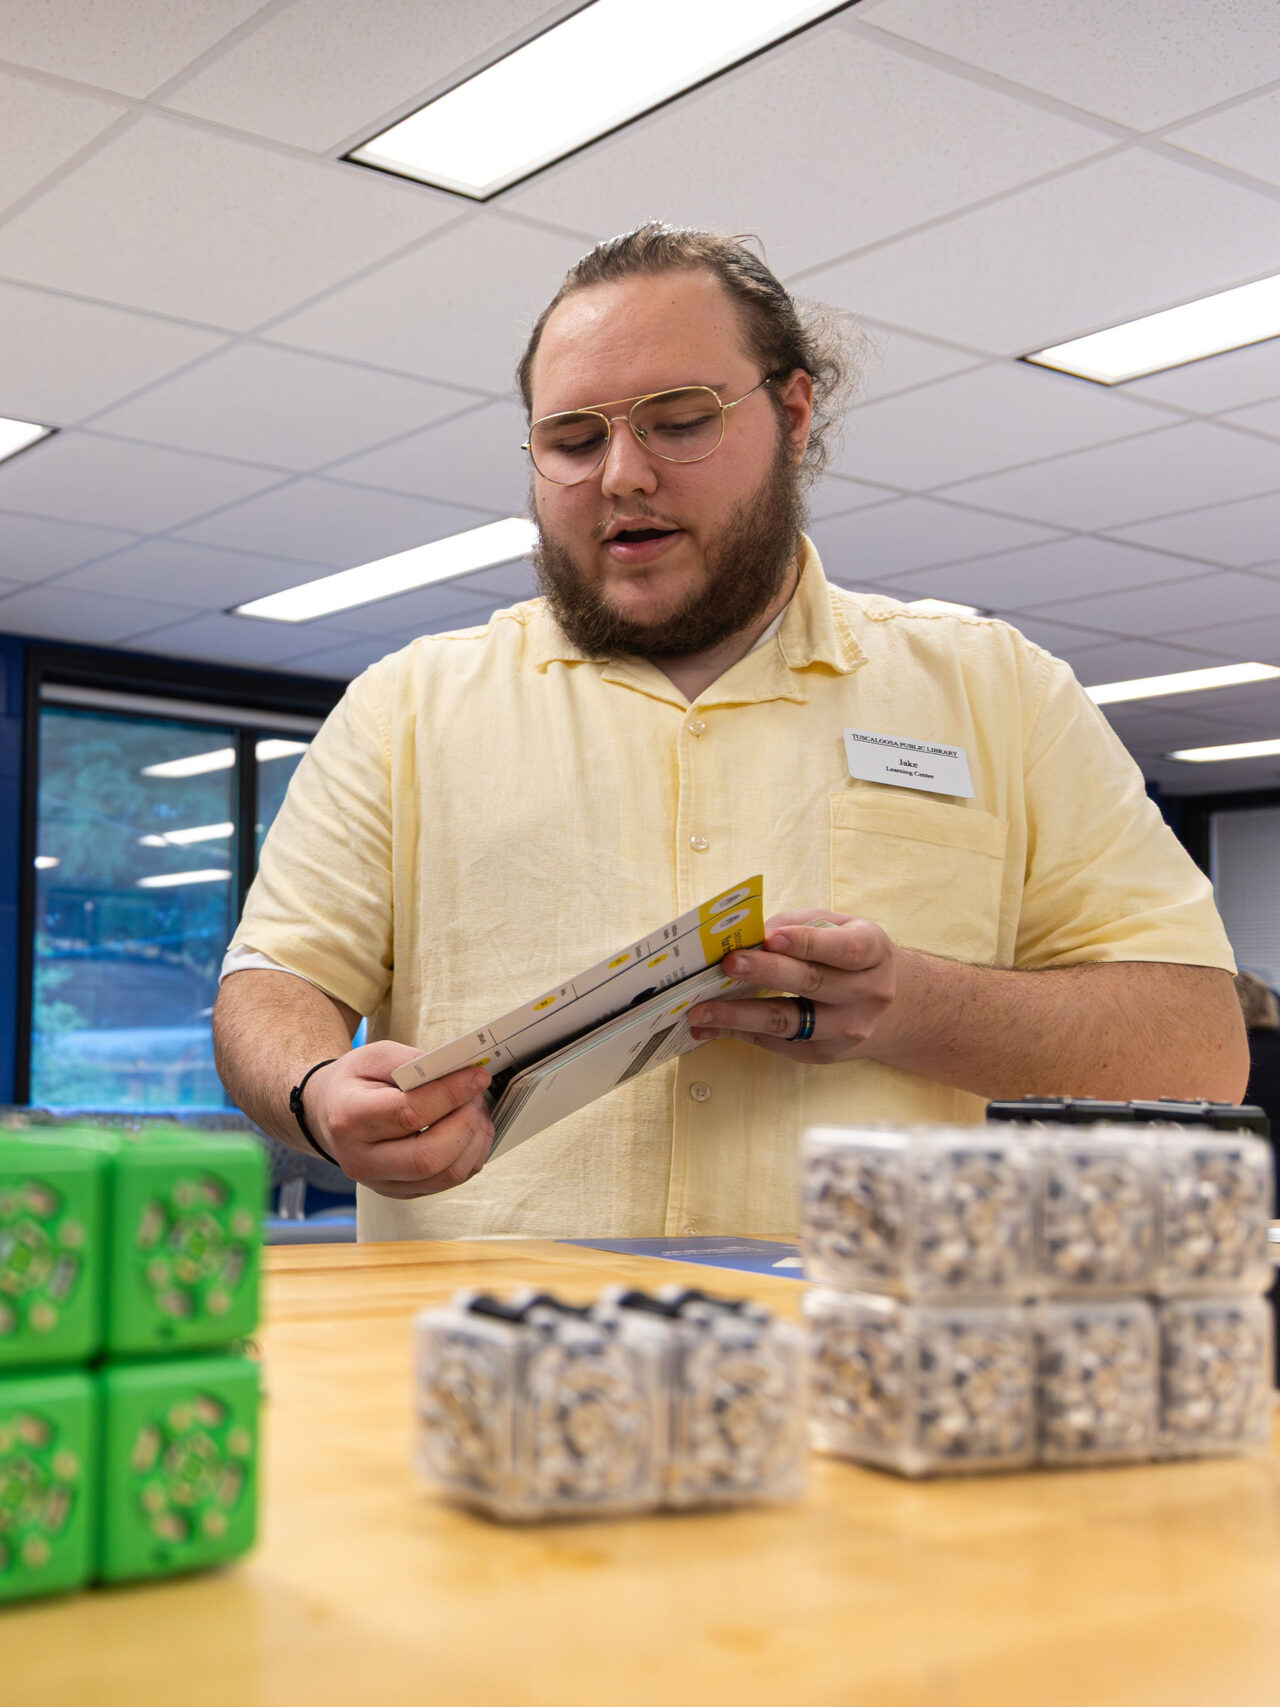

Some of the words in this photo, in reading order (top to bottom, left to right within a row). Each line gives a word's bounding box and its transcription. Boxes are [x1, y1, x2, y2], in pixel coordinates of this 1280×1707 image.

[852, 734, 899, 746] TUSCALOOSA
[899, 742, 925, 750] PUBLIC
[926, 747, 958, 757] LIBRARY
[899, 759, 918, 768] Jake
[885, 766, 913, 776] Learning
[914, 771, 934, 779] Center
